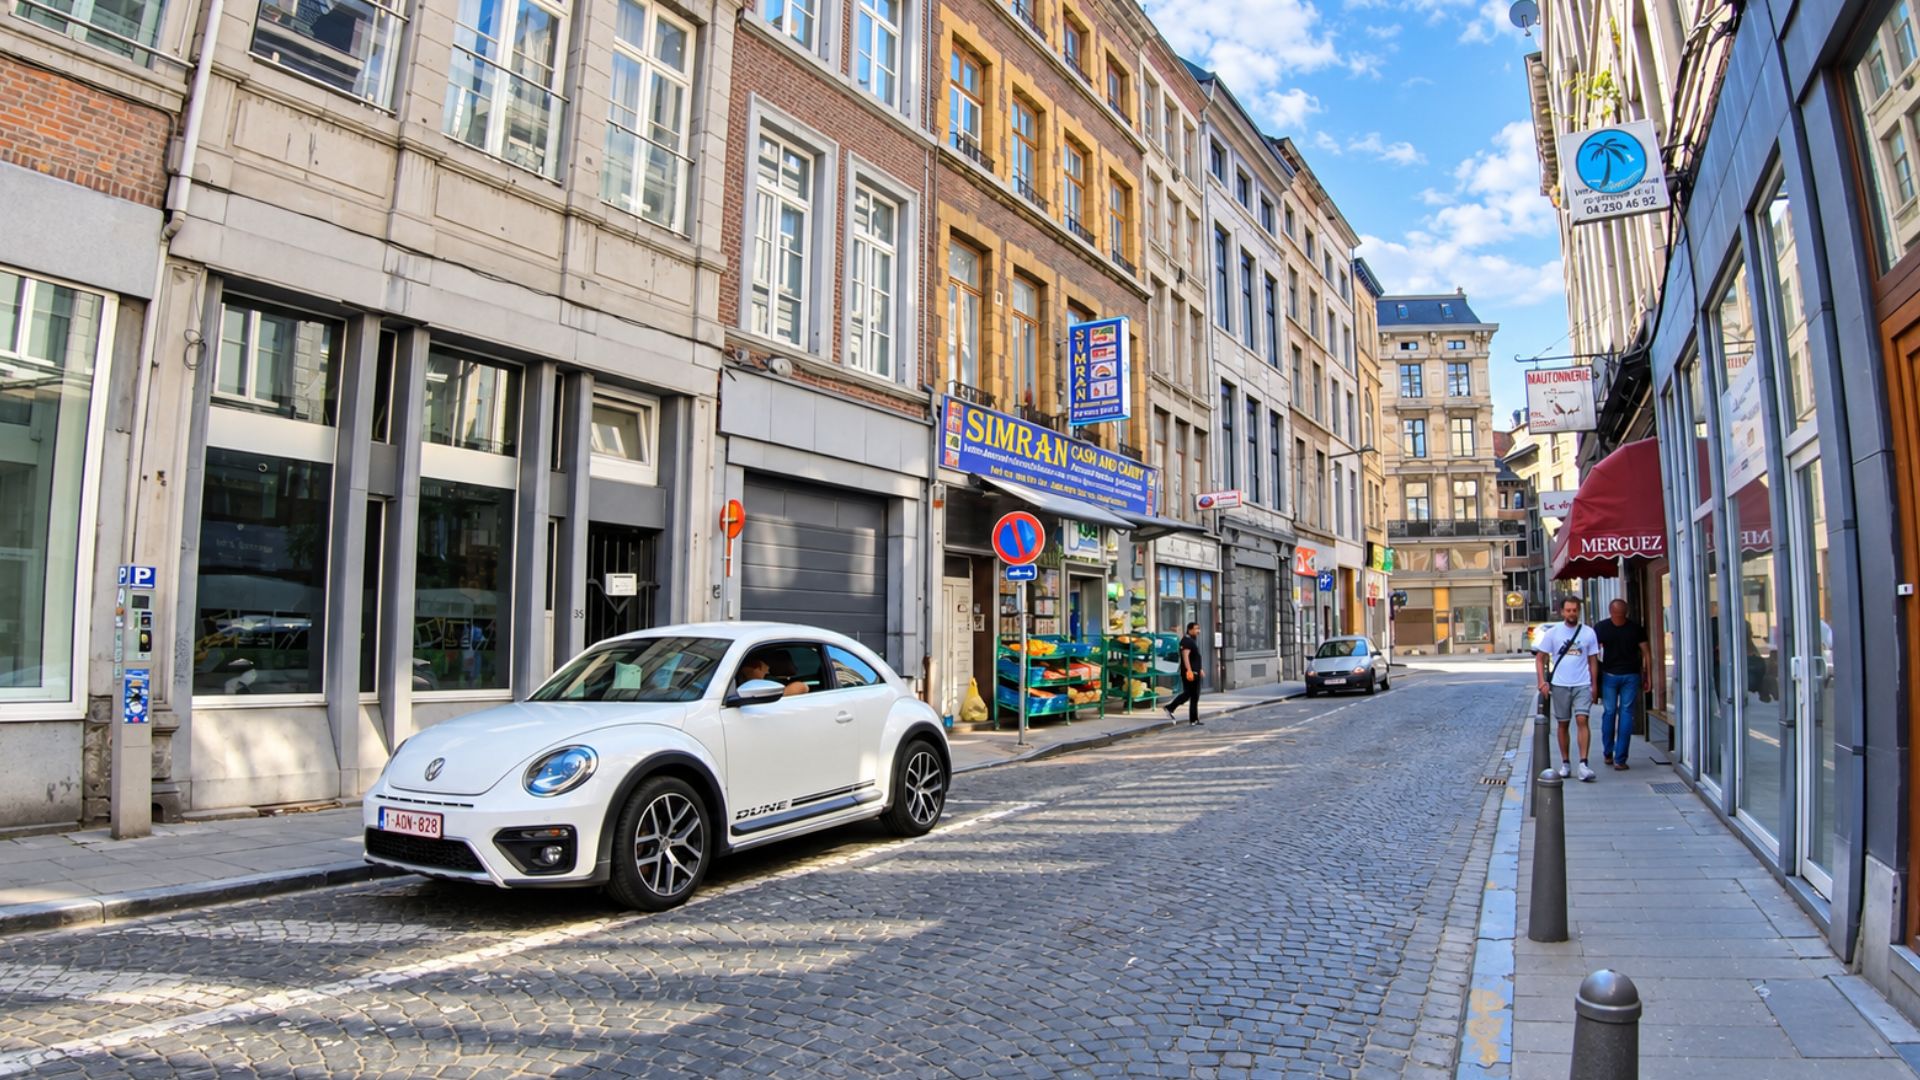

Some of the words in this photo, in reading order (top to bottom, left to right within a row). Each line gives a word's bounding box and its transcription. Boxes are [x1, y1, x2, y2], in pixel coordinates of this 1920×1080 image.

[965, 408, 1068, 468] SIMRAN
[1581, 535, 1662, 553] MERGUEZ
[134, 567, 152, 584] P
[735, 800, 789, 820] DUNE
